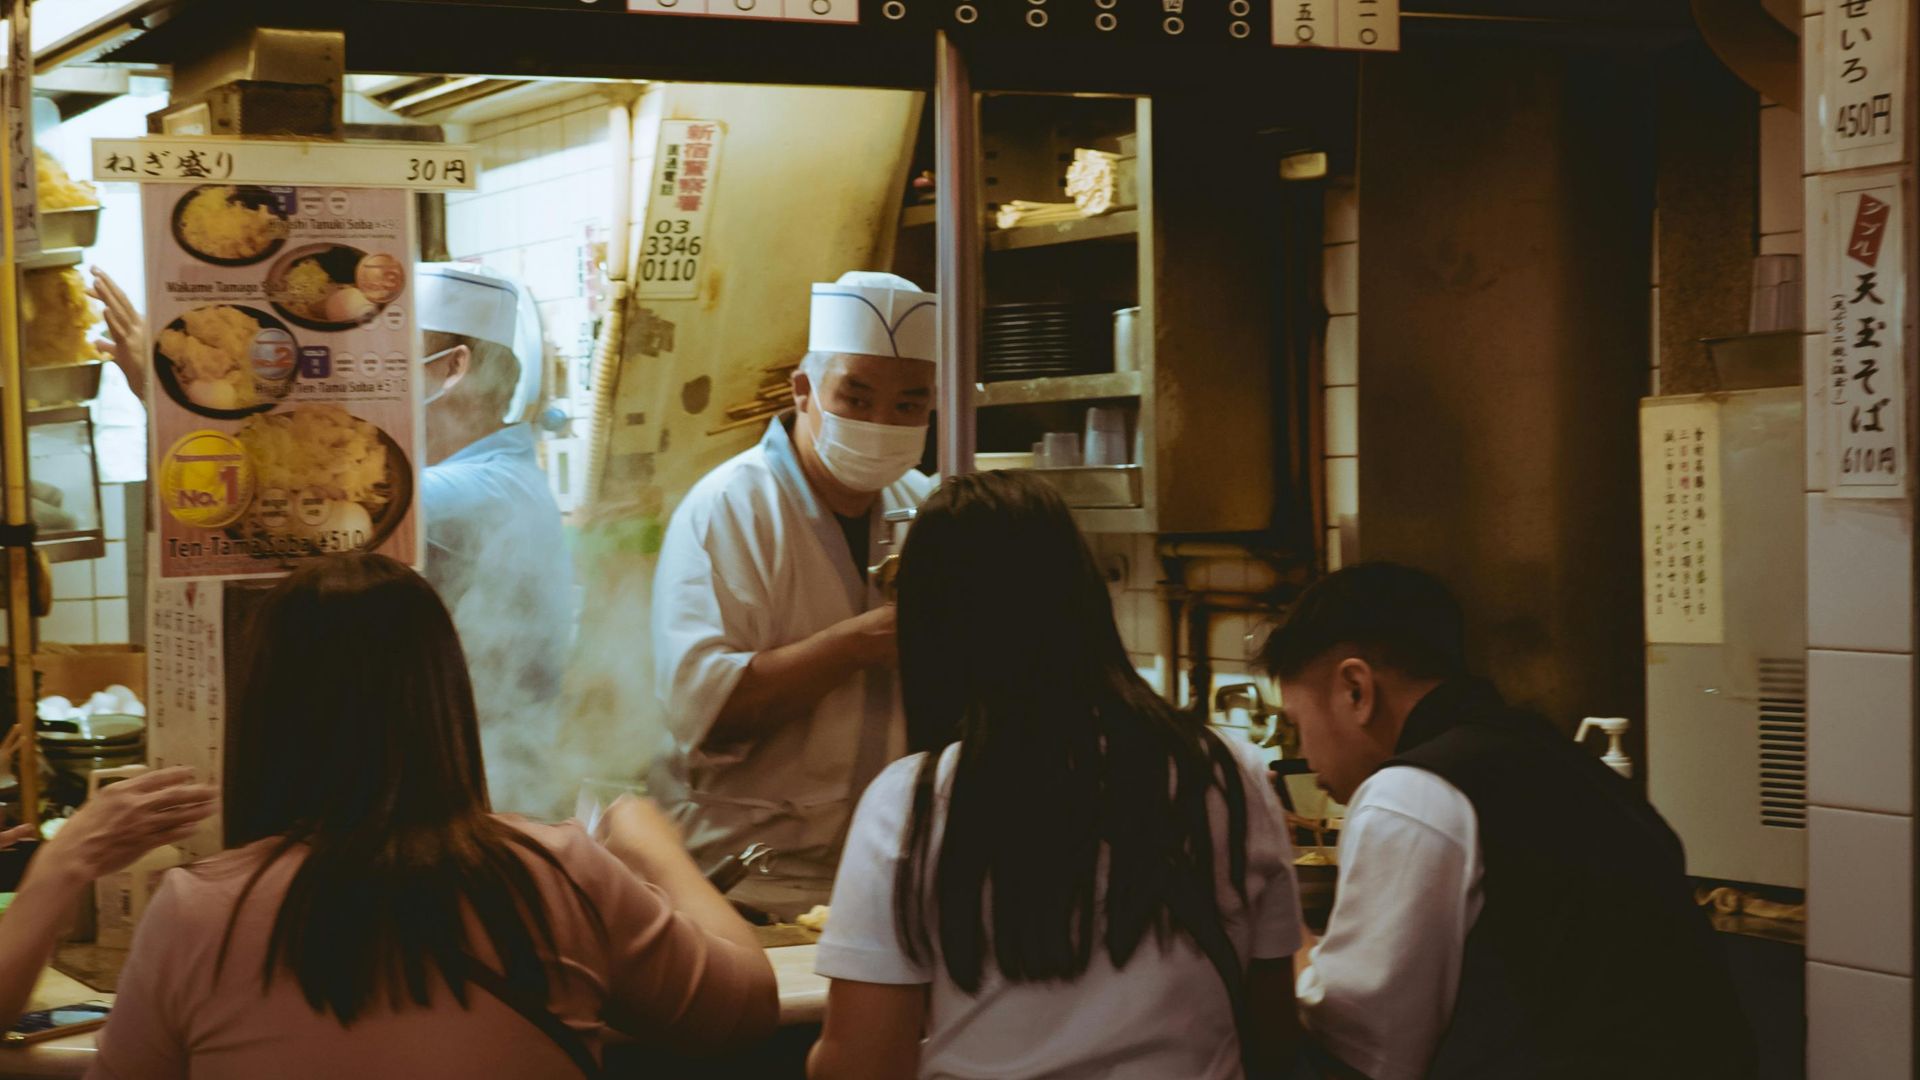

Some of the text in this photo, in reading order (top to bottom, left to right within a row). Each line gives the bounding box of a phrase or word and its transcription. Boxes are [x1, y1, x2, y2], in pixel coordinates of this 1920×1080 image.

[1839, 0, 1873, 84] せいろ
[1836, 93, 1892, 138] 450円
[103, 149, 468, 184] ねぎ盛り 30円
[311, 218, 344, 230] Tanuki
[346, 217, 373, 230] Soba
[656, 220, 690, 234] 03
[646, 236, 701, 256] 3346
[642, 259, 697, 281] 0110
[165, 281, 213, 293] Wakame
[215, 281, 258, 296] Tamago
[1849, 271, 1890, 434] 天玉そば
